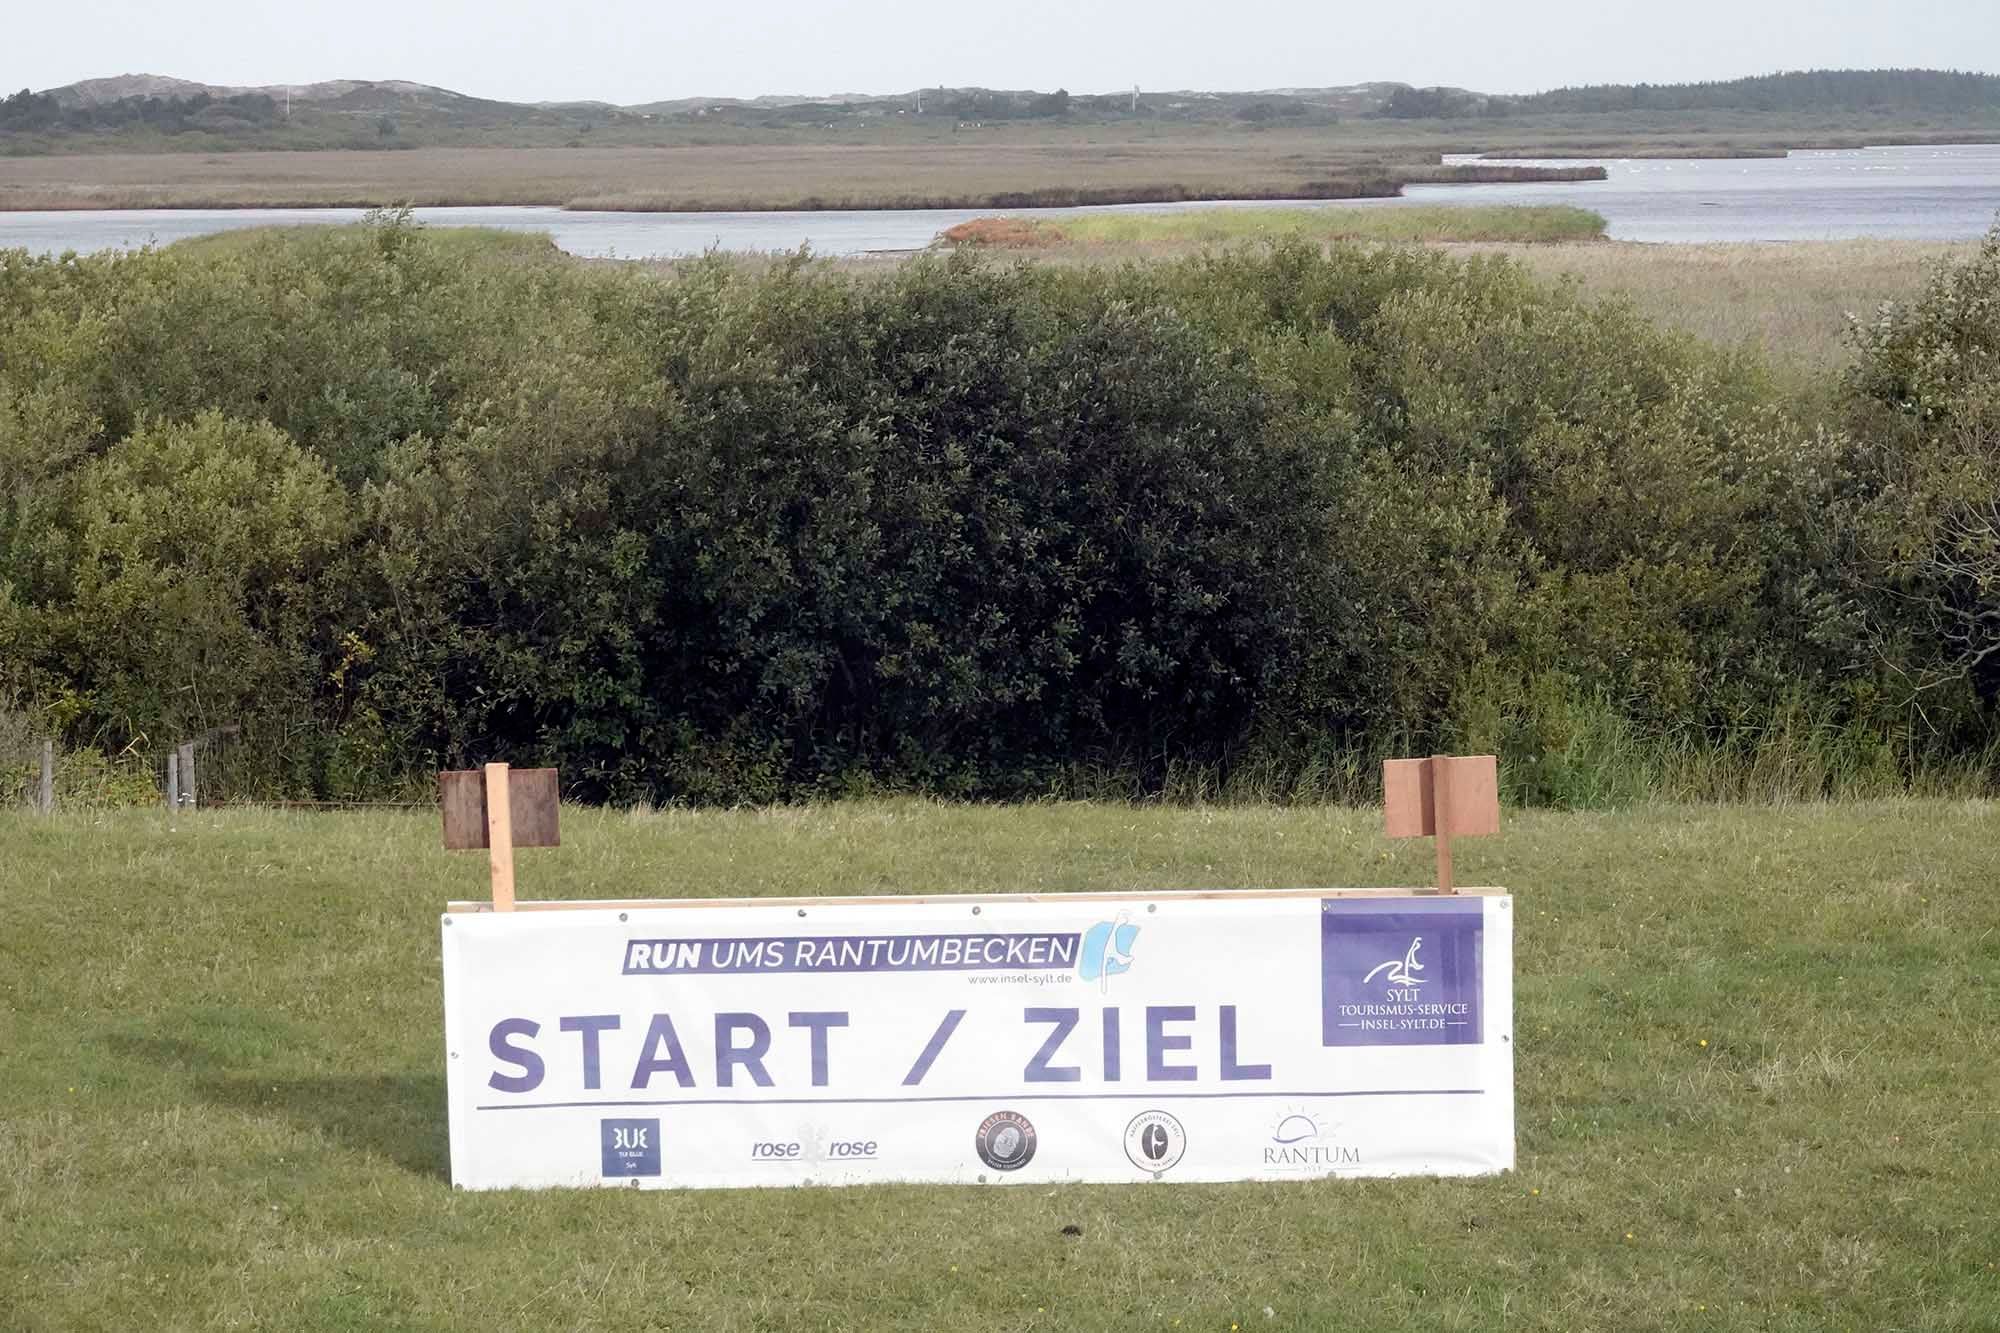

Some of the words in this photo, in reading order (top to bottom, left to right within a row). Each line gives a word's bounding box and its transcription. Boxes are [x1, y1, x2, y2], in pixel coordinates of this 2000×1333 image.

[628, 943, 702, 969] RUN
[711, 941, 785, 968] UMS
[794, 937, 1074, 967] RANTUMBECKEN
[968, 974, 1073, 985] www.insel-sylt.de
[1386, 988, 1421, 1002] SYLT
[1339, 1003, 1469, 1016] TOURISMUS-SERVICE
[1361, 1018, 1446, 1031] INSEL-SYLT.DE
[487, 1011, 849, 1094] START
[901, 1010, 967, 1086] /
[1023, 1005, 1272, 1082] ZIEL
[751, 1141, 801, 1157] rose
[828, 1140, 878, 1156] rose
[1264, 1146, 1360, 1164] RANTUM
